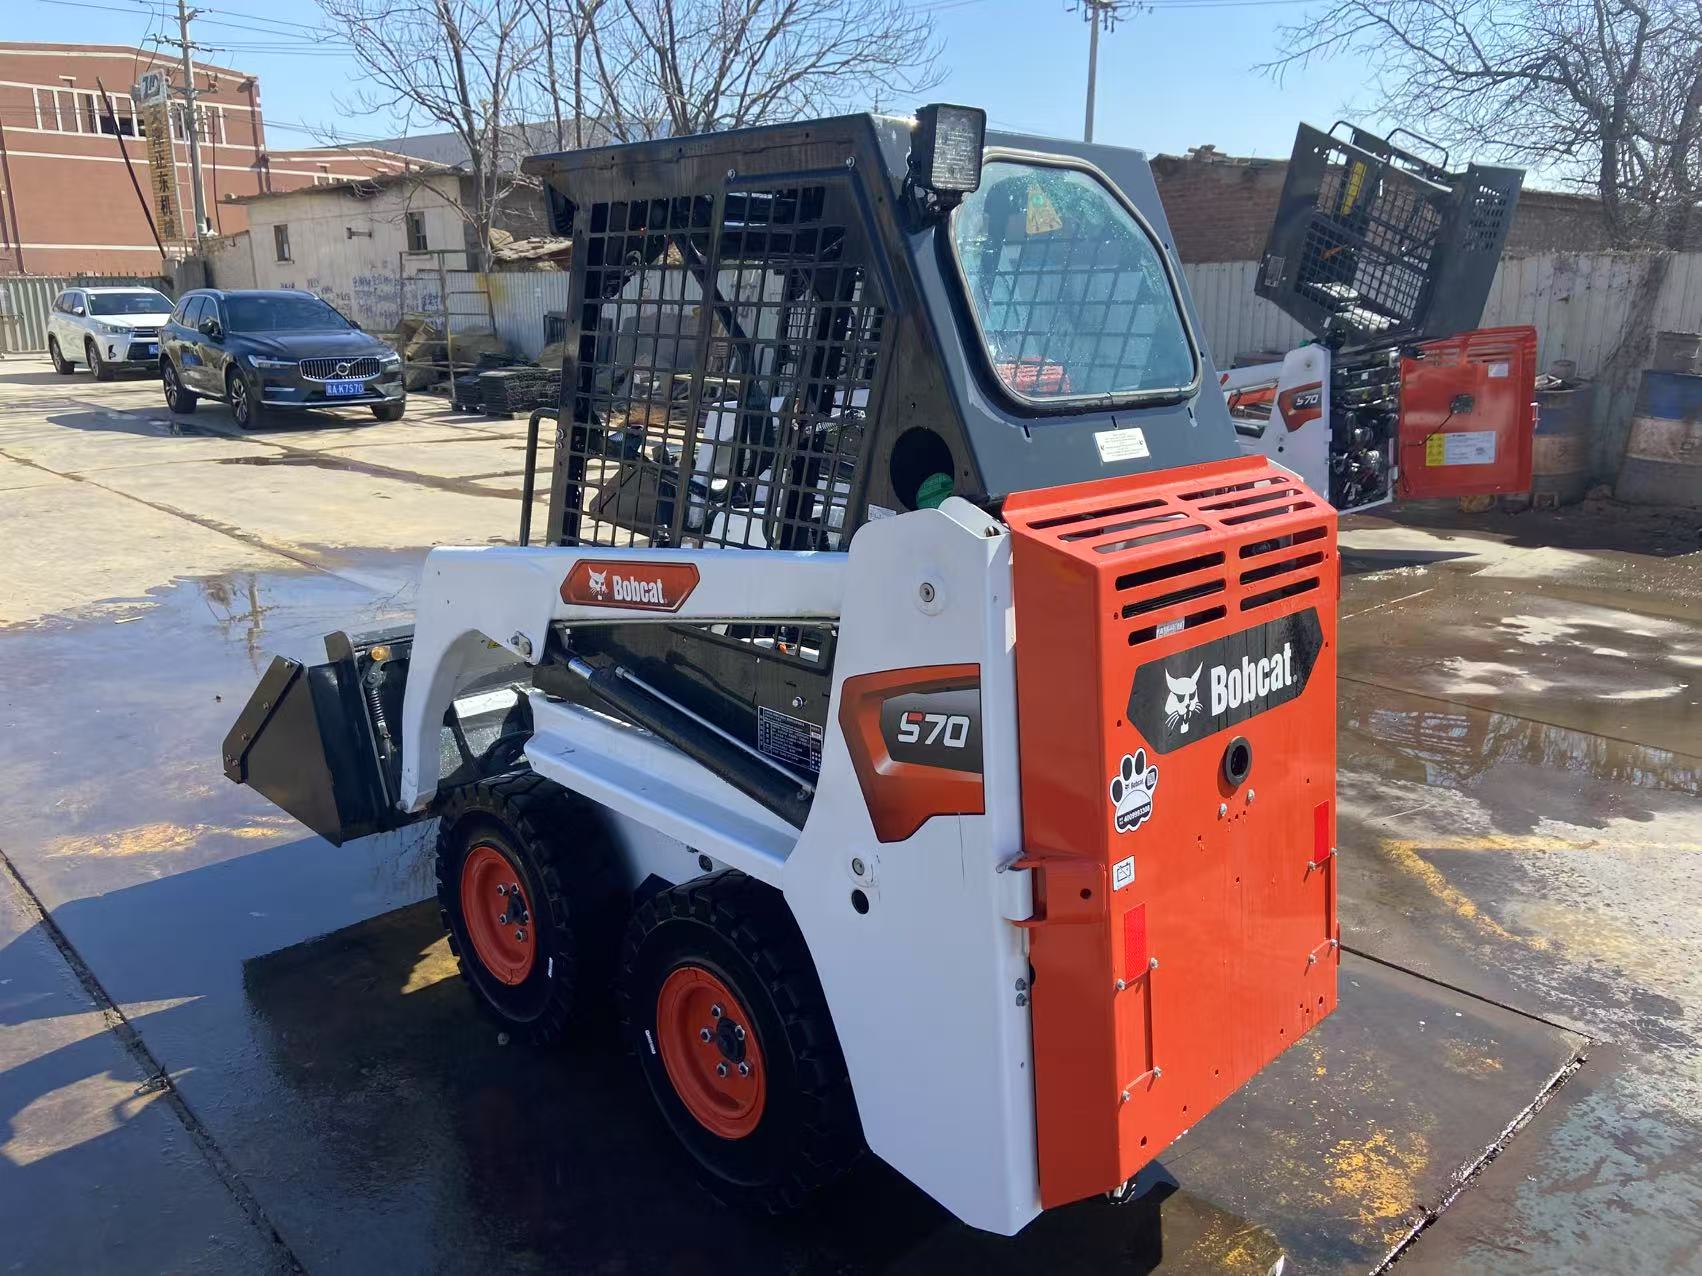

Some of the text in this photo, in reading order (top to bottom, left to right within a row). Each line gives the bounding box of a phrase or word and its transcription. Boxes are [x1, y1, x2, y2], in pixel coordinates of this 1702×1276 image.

[1295, 394, 1319, 406] S70
[612, 575, 665, 604] Bobcat
[1210, 641, 1292, 717] Bobcat
[897, 711, 970, 748] S70
